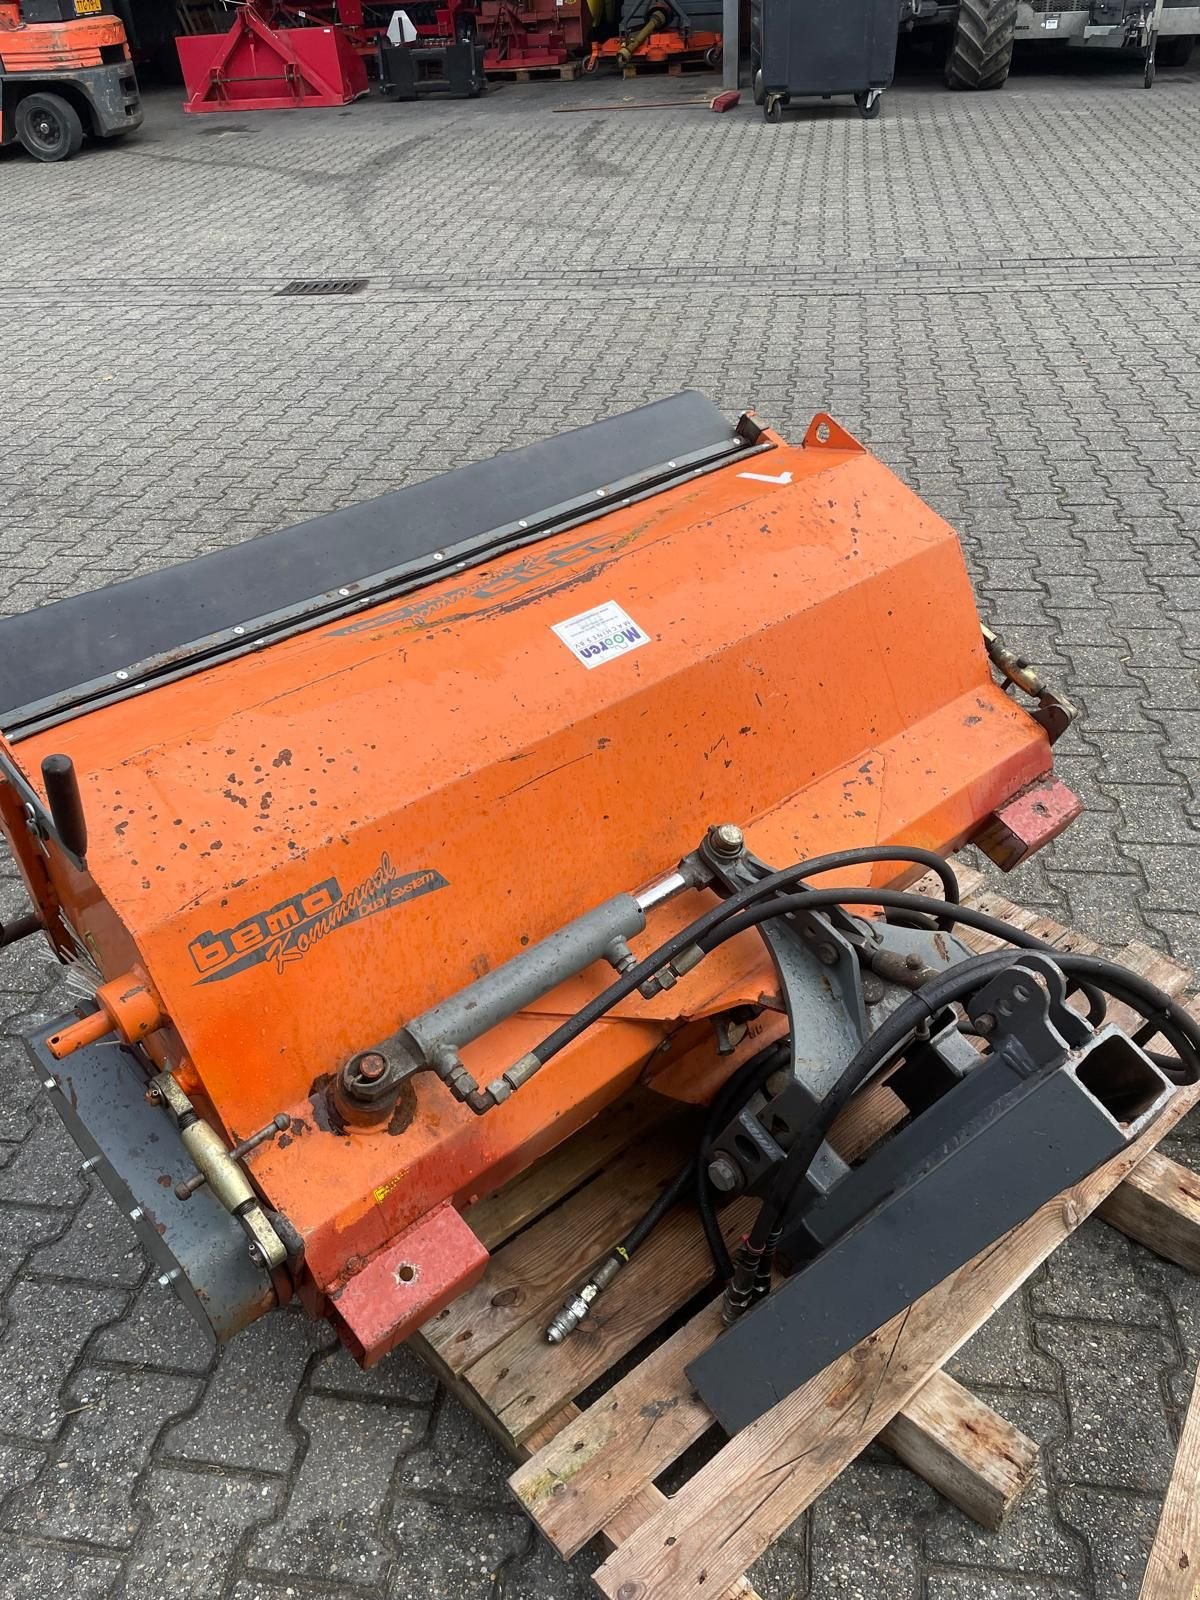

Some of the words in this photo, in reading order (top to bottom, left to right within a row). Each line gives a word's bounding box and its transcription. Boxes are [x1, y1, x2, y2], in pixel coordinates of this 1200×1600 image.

[575, 640, 586, 649] BV
[580, 626, 642, 659] Mooren
[586, 620, 631, 643] MACHINES
[266, 851, 398, 975] Kommunal
[357, 894, 389, 918] Dual
[390, 871, 436, 900] System
[189, 886, 336, 972] bema
